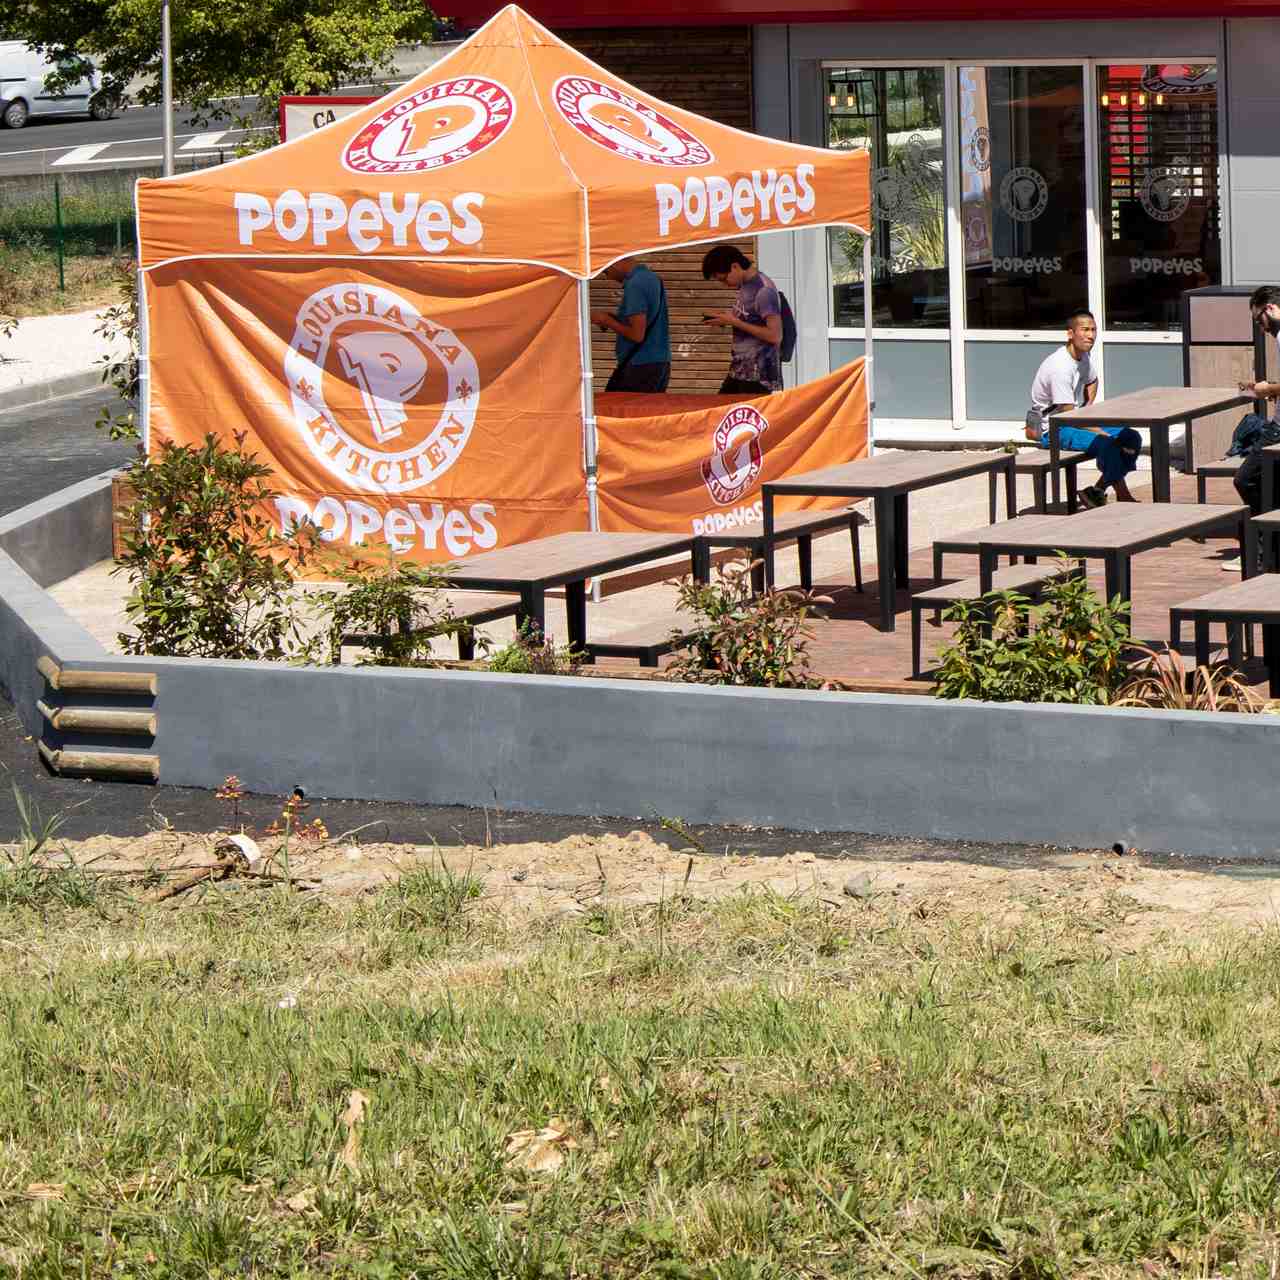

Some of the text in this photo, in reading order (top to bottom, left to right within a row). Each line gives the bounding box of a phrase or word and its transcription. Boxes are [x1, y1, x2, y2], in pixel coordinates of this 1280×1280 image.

[377, 80, 508, 128] LOUISIANA
[559, 80, 656, 126] LOUISIANA
[349, 147, 474, 173] KITCHEN
[615, 139, 710, 165] KITCHEN
[306, 414, 465, 484] KITCHEN
